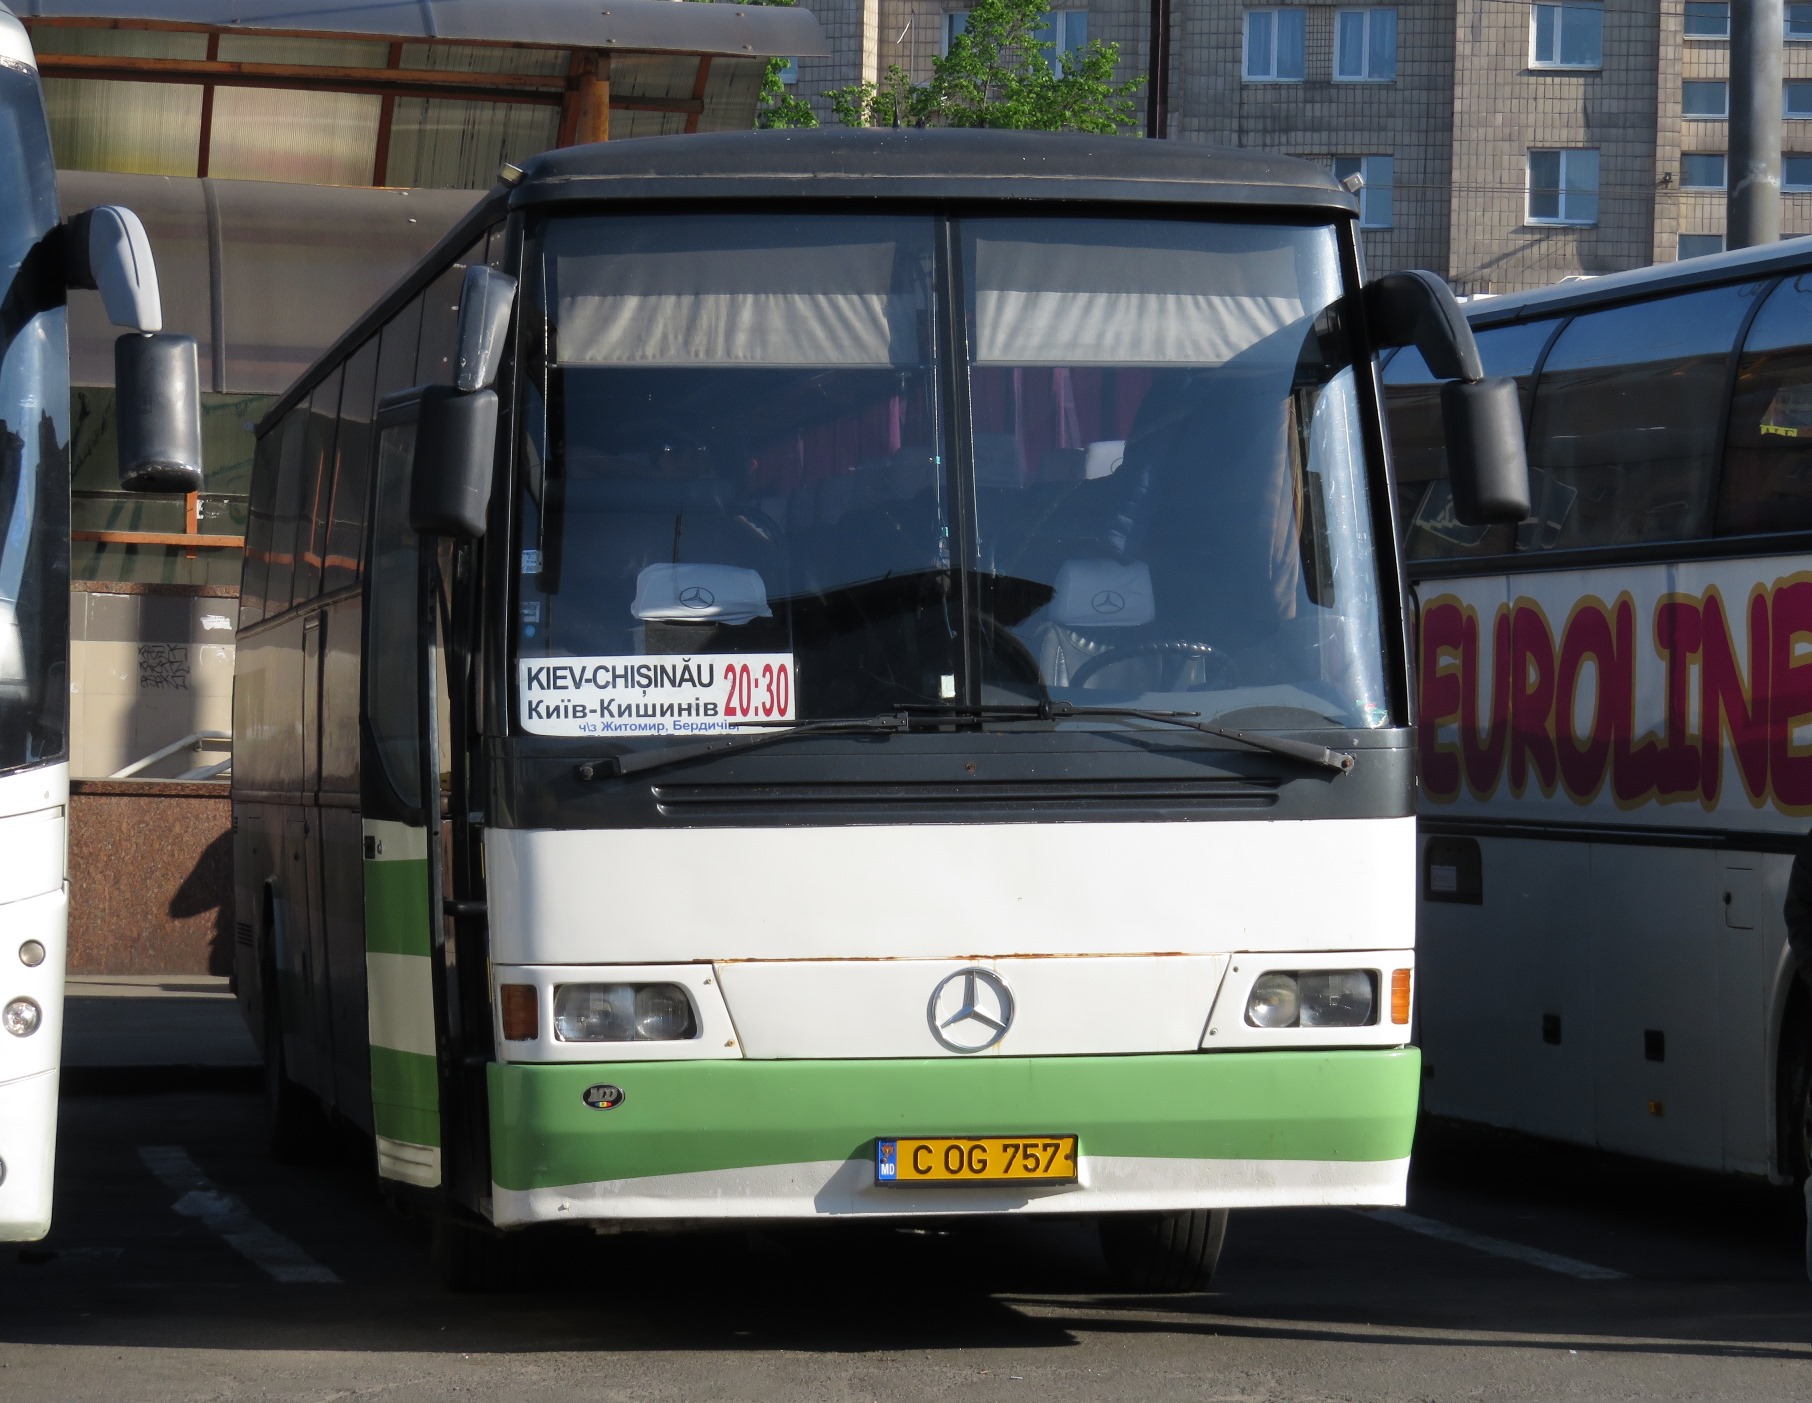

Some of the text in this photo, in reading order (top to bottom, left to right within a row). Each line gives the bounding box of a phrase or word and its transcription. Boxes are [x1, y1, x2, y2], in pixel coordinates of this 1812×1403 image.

[723, 663, 789, 717] 20:30
[1420, 570, 1812, 818] EUROLINE
[527, 697, 719, 720] Київ-Кишинів
[601, 720, 669, 733] Житомир,
[881, 1163, 895, 1176] MD
[913, 1144, 934, 1175] C
[1002, 1142, 1061, 1174] 757
